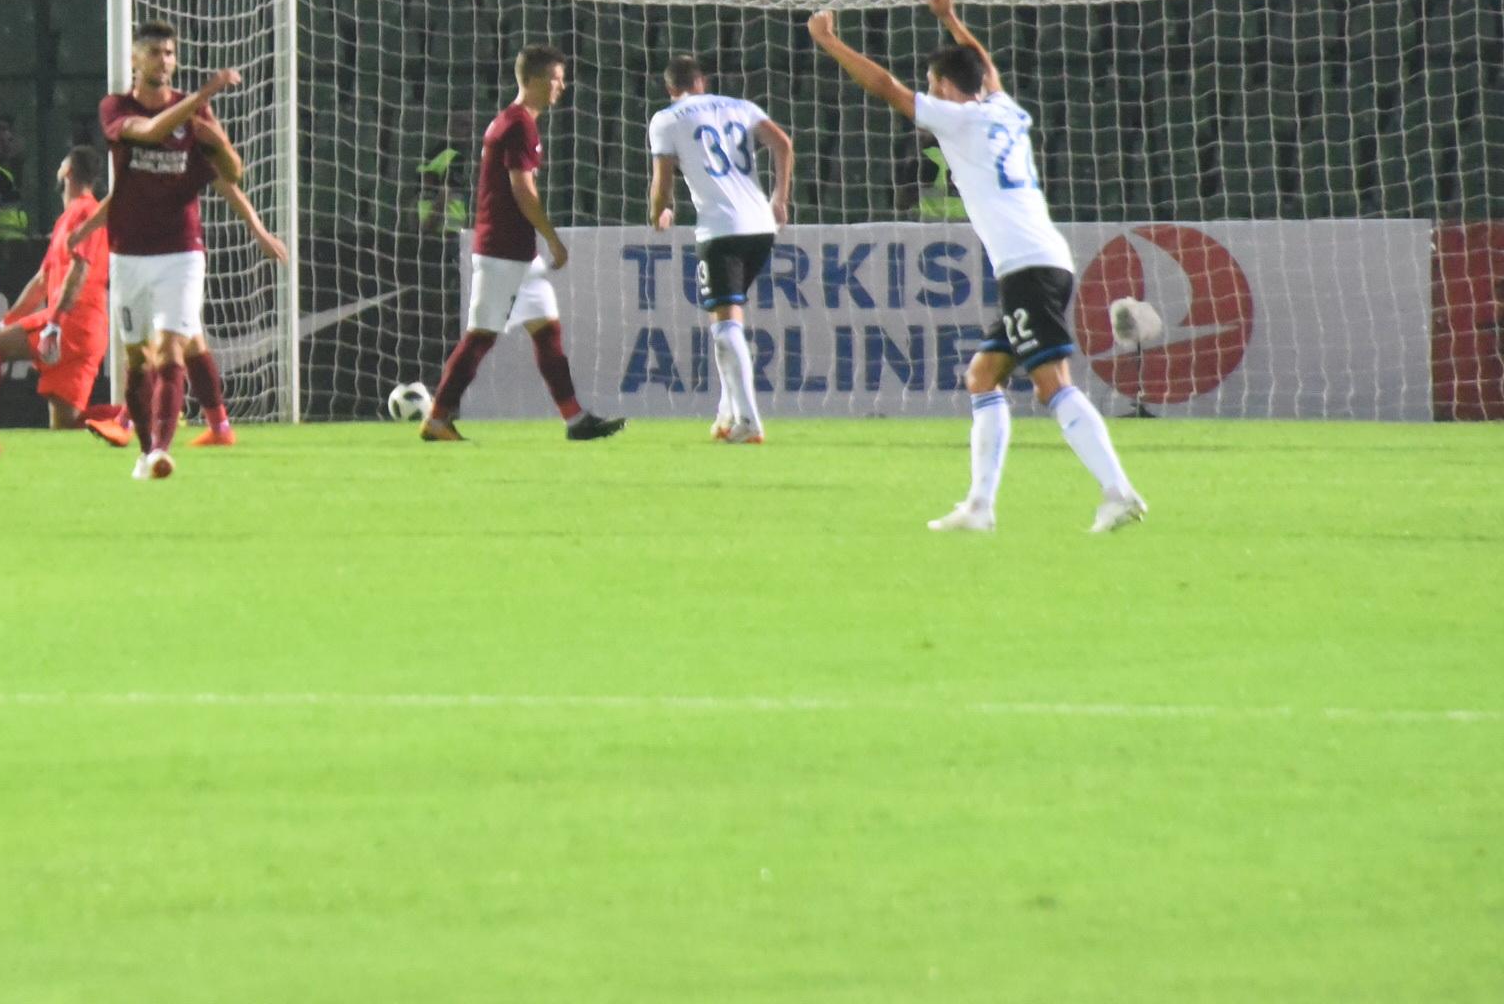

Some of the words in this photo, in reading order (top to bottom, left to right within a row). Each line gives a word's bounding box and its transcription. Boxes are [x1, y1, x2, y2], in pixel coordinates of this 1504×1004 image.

[694, 122, 752, 177] 33
[1002, 307, 1034, 345] 22
[620, 324, 1034, 393] AIRLINE
